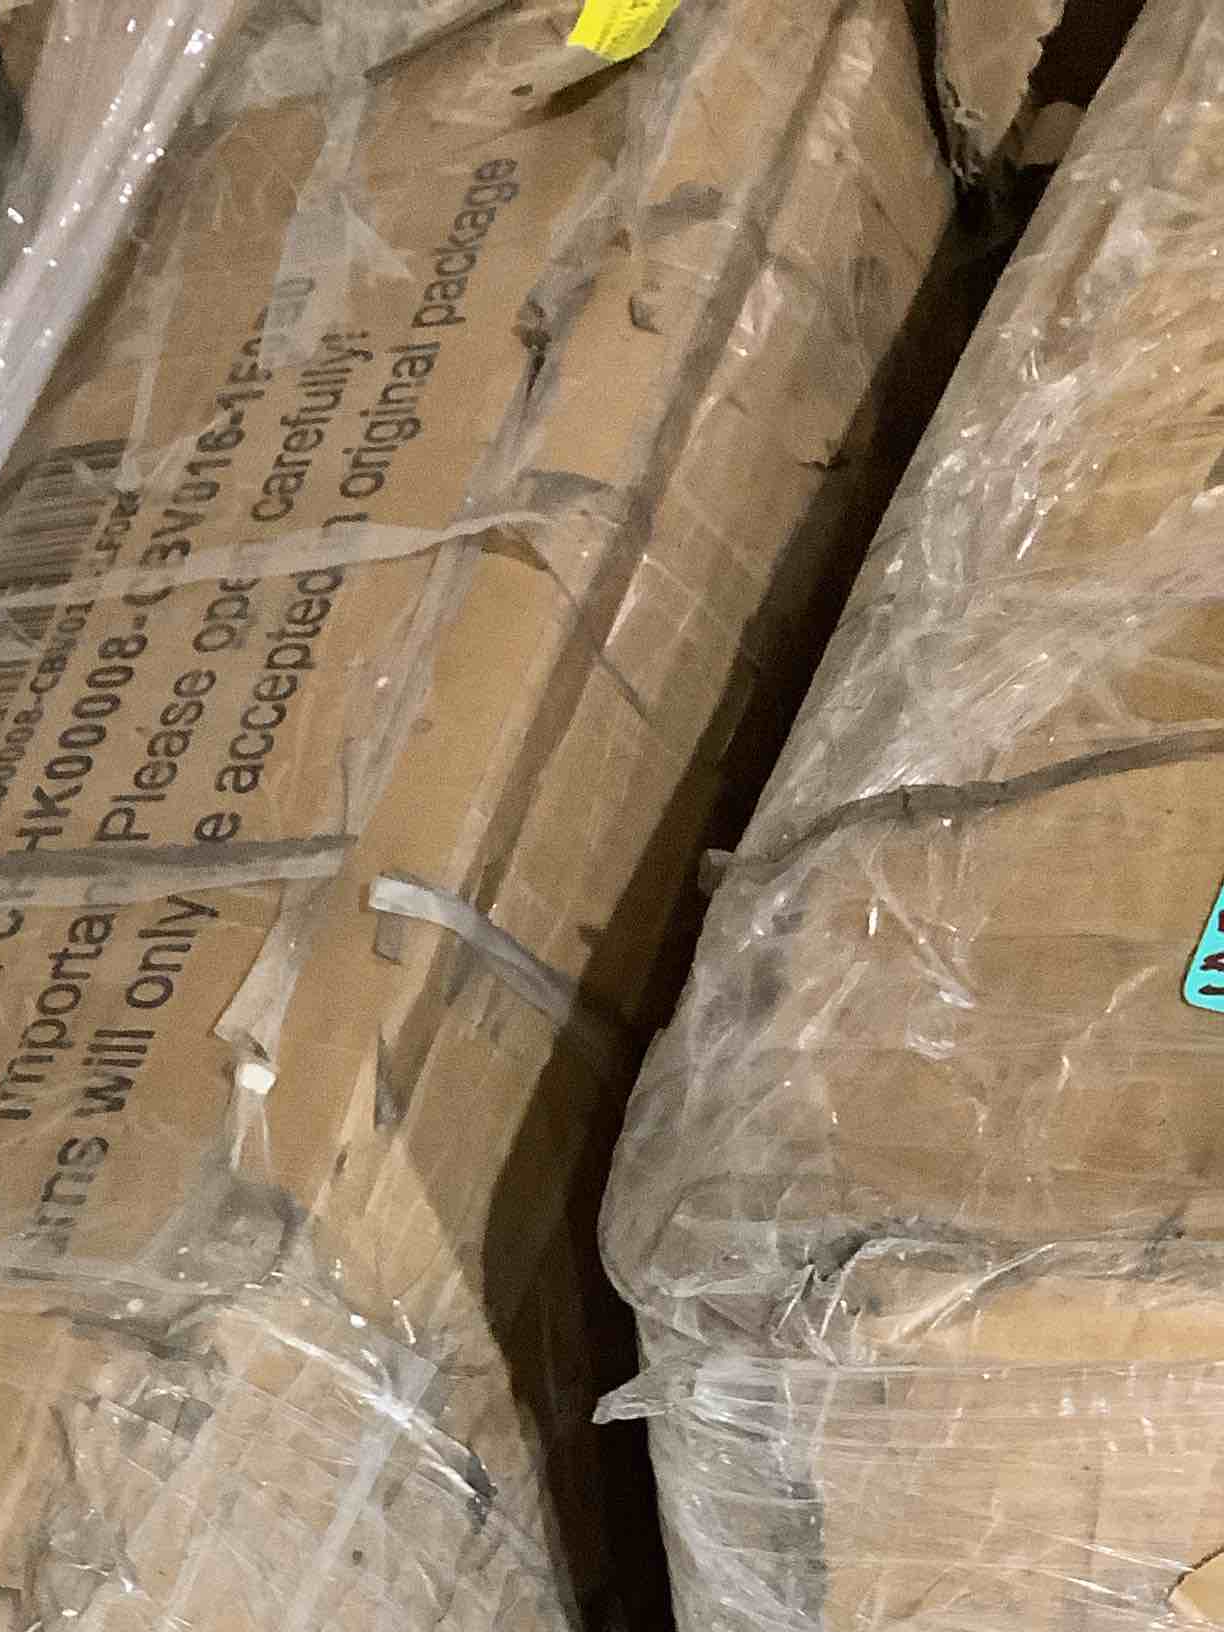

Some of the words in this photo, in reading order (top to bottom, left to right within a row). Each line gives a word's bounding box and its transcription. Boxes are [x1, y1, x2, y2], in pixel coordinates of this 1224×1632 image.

[74, 1029, 155, 1117] will
[126, 895, 219, 1010] only
[215, 565, 344, 794] accepted
[340, 341, 439, 498] original
[412, 158, 519, 328] package
[95, 669, 217, 843] Please
[192, 538, 273, 653] ope
